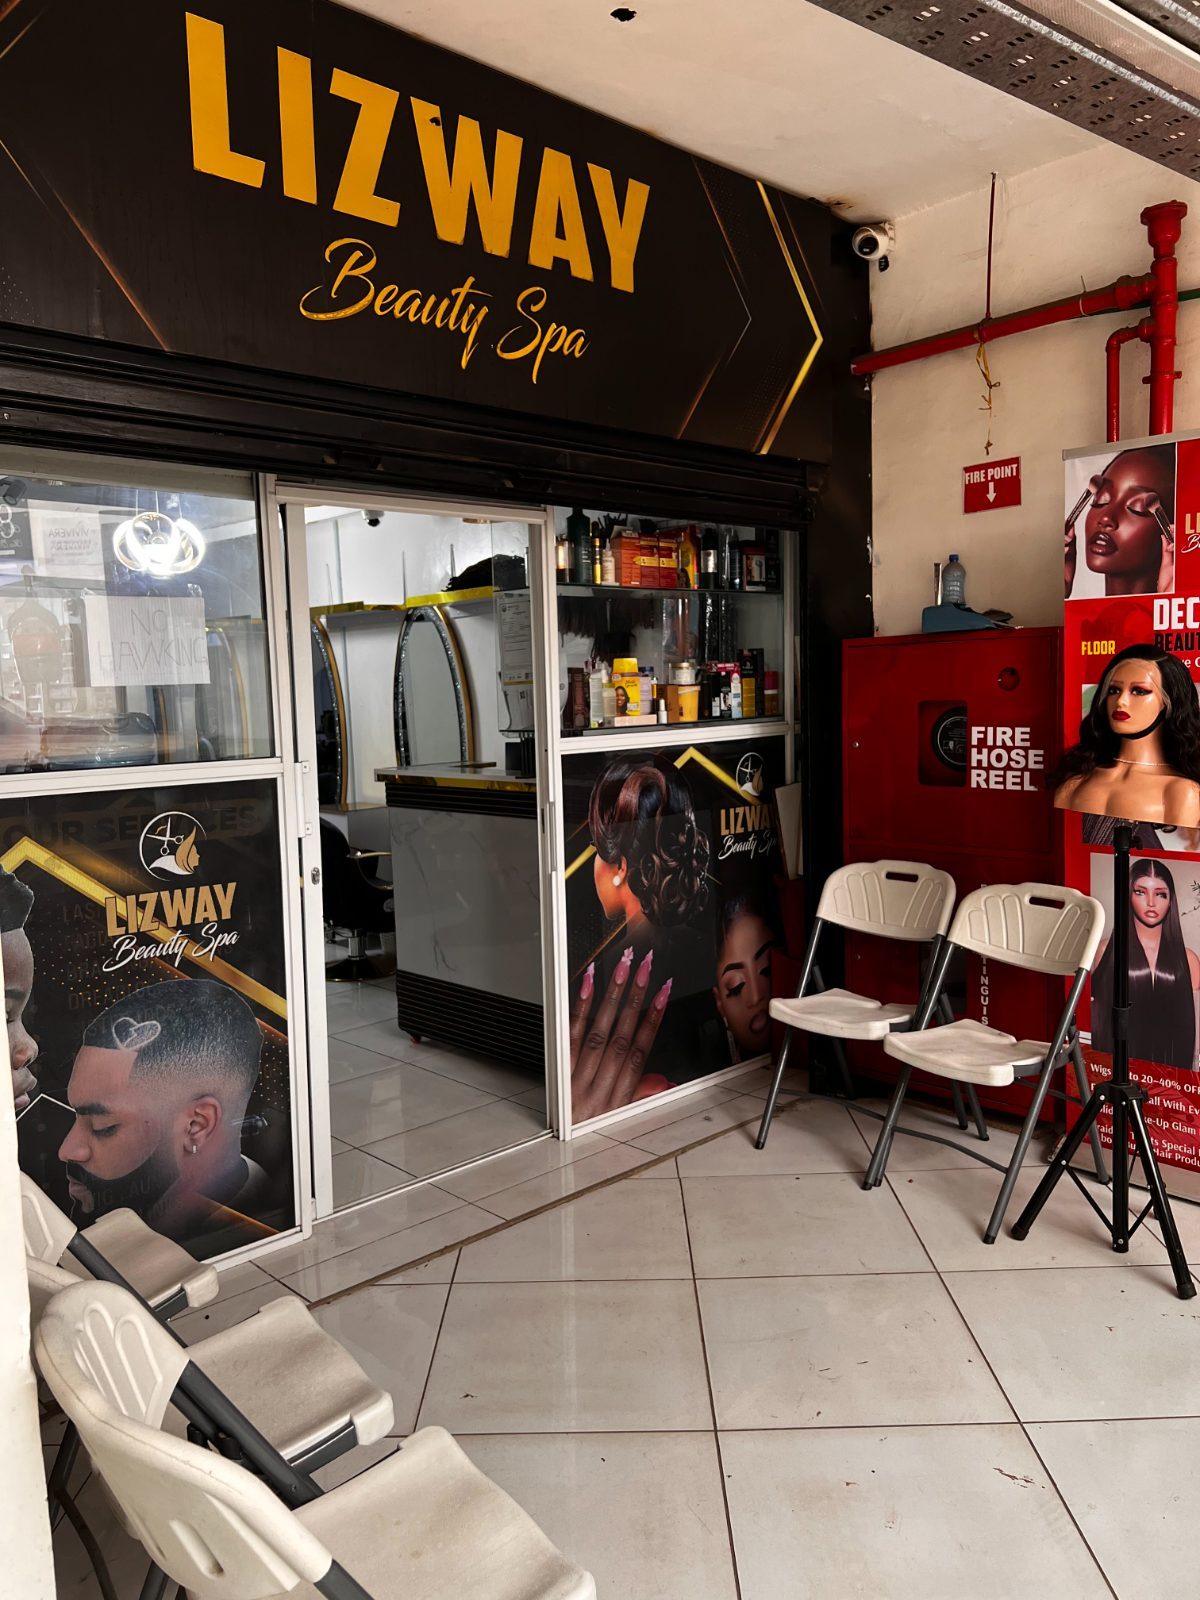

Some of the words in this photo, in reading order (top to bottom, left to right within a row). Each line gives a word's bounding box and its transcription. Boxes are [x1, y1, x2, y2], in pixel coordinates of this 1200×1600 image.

[185, 12, 650, 293] LIZWAY
[300, 237, 493, 369] Beauty
[496, 286, 590, 384] Spa
[965, 470, 986, 485] FIRE
[987, 464, 1018, 480] POINT
[130, 608, 167, 636] NO
[1081, 640, 1116, 656] FLOOR
[970, 726, 1031, 747] FIRE
[970, 747, 1044, 769] HOSE
[970, 769, 1039, 791] REEL
[720, 805, 771, 836] LIZWA
[718, 833, 758, 860] Beauty
[104, 882, 237, 937] LIZWAY
[102, 930, 192, 972] Beauty
[192, 922, 240, 962] Spa
[1090, 1063, 1112, 1077] Wigs
[1129, 1071, 1139, 1081] to
[1163, 1098, 1186, 1112] With
[1171, 1121, 1196, 1135] Glam
[1161, 1139, 1196, 1156] Special
